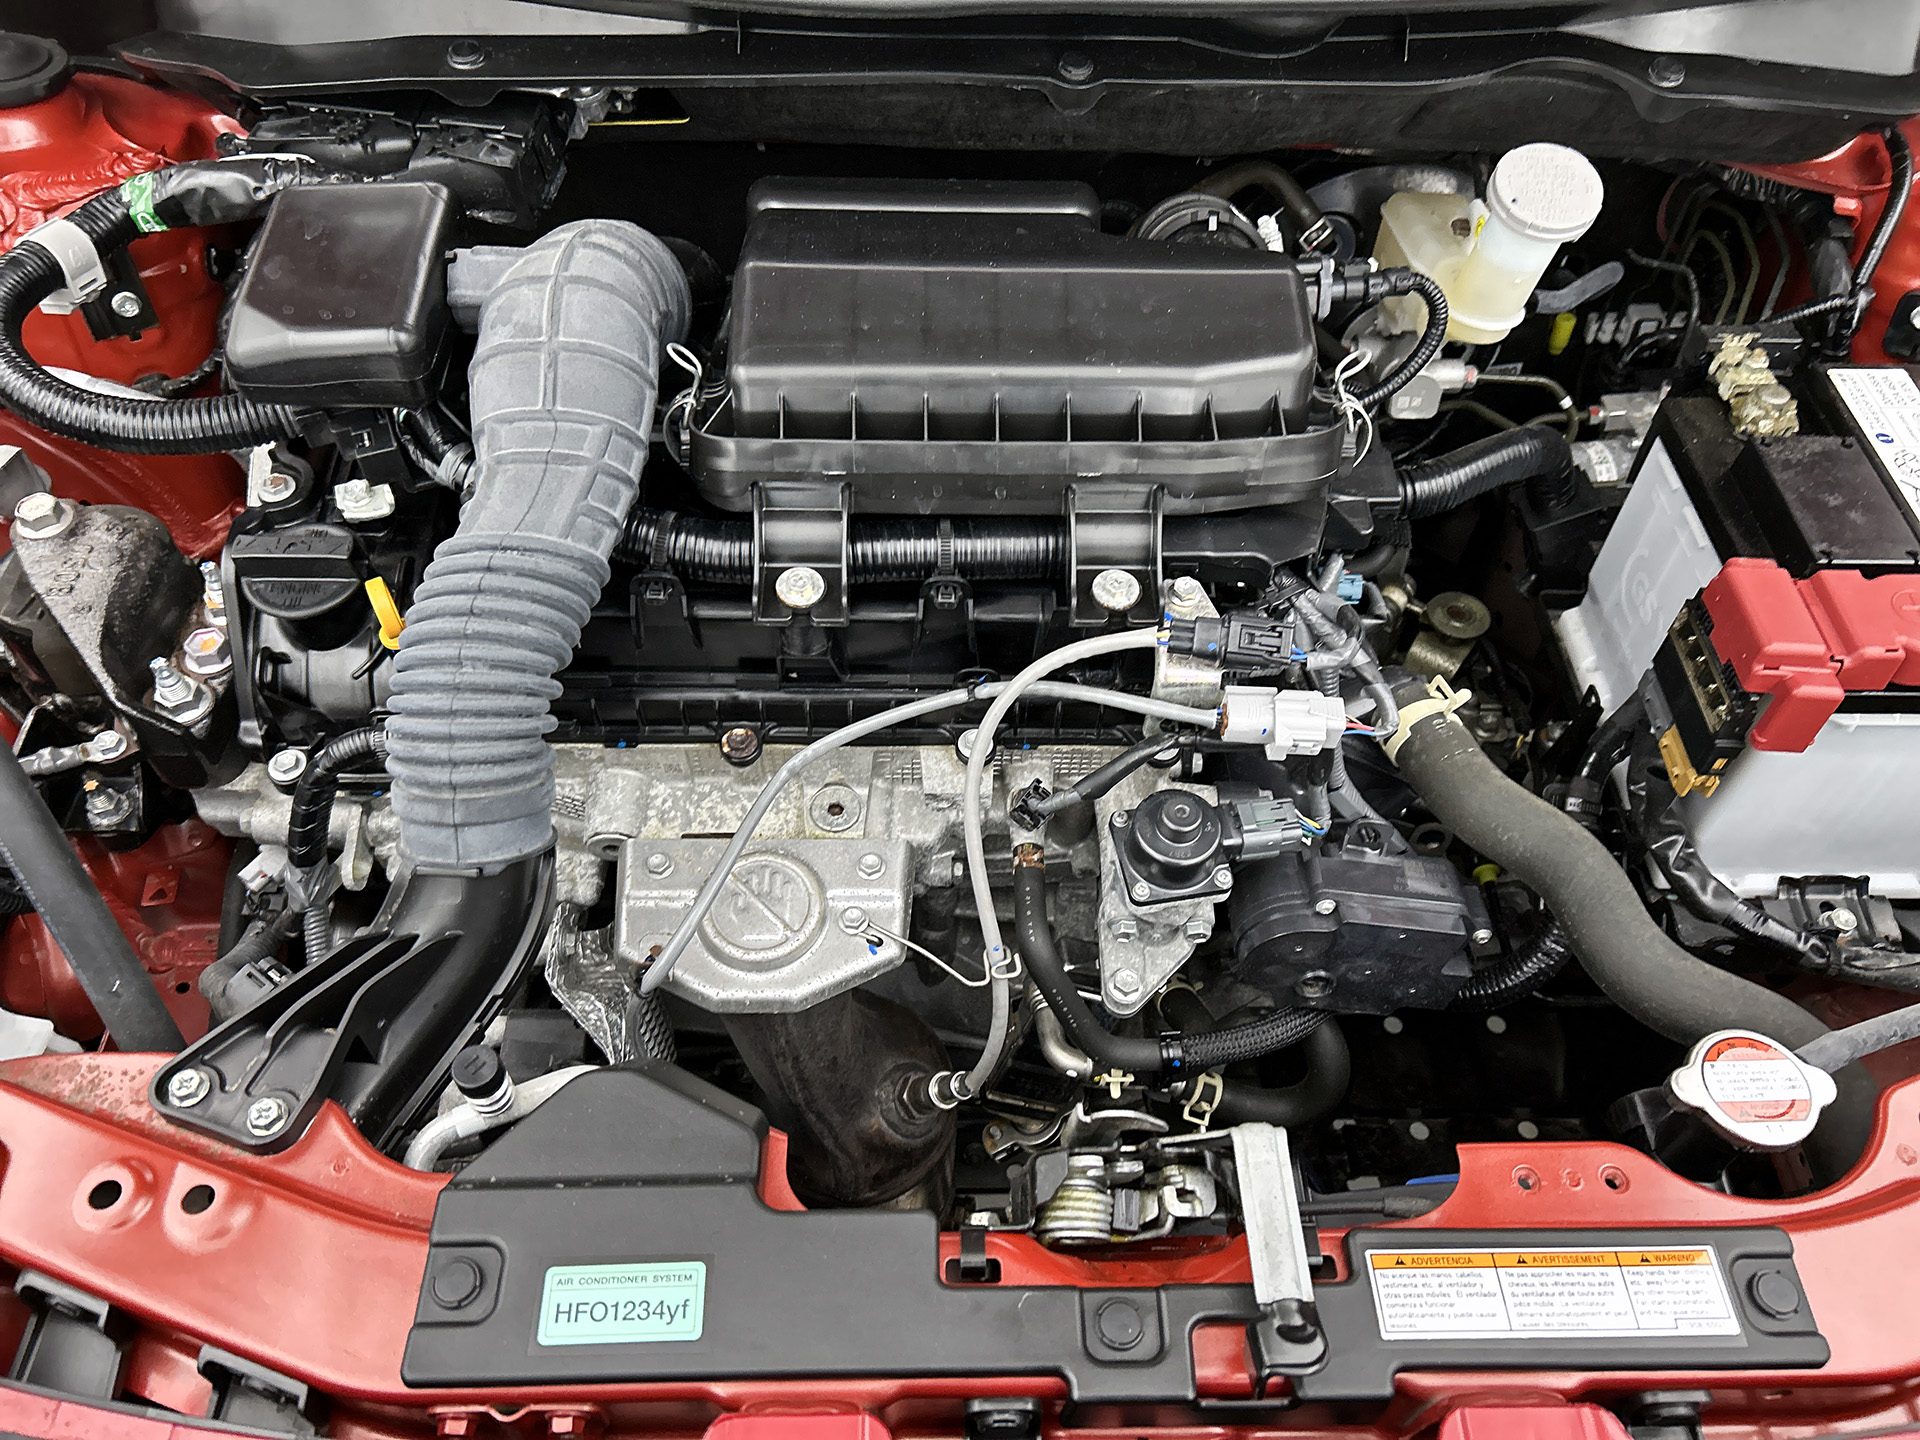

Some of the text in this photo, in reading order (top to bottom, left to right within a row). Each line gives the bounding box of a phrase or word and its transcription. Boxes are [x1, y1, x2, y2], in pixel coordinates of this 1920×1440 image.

[1411, 1256, 1474, 1265] ADVERTENCIA
[1532, 1255, 1606, 1264] AVERTISSEMENT
[1653, 1254, 1696, 1262] WARNING
[556, 1274, 692, 1286] AIR CONDITIONER SYSTEM
[554, 1299, 690, 1326] HFO1234yf
